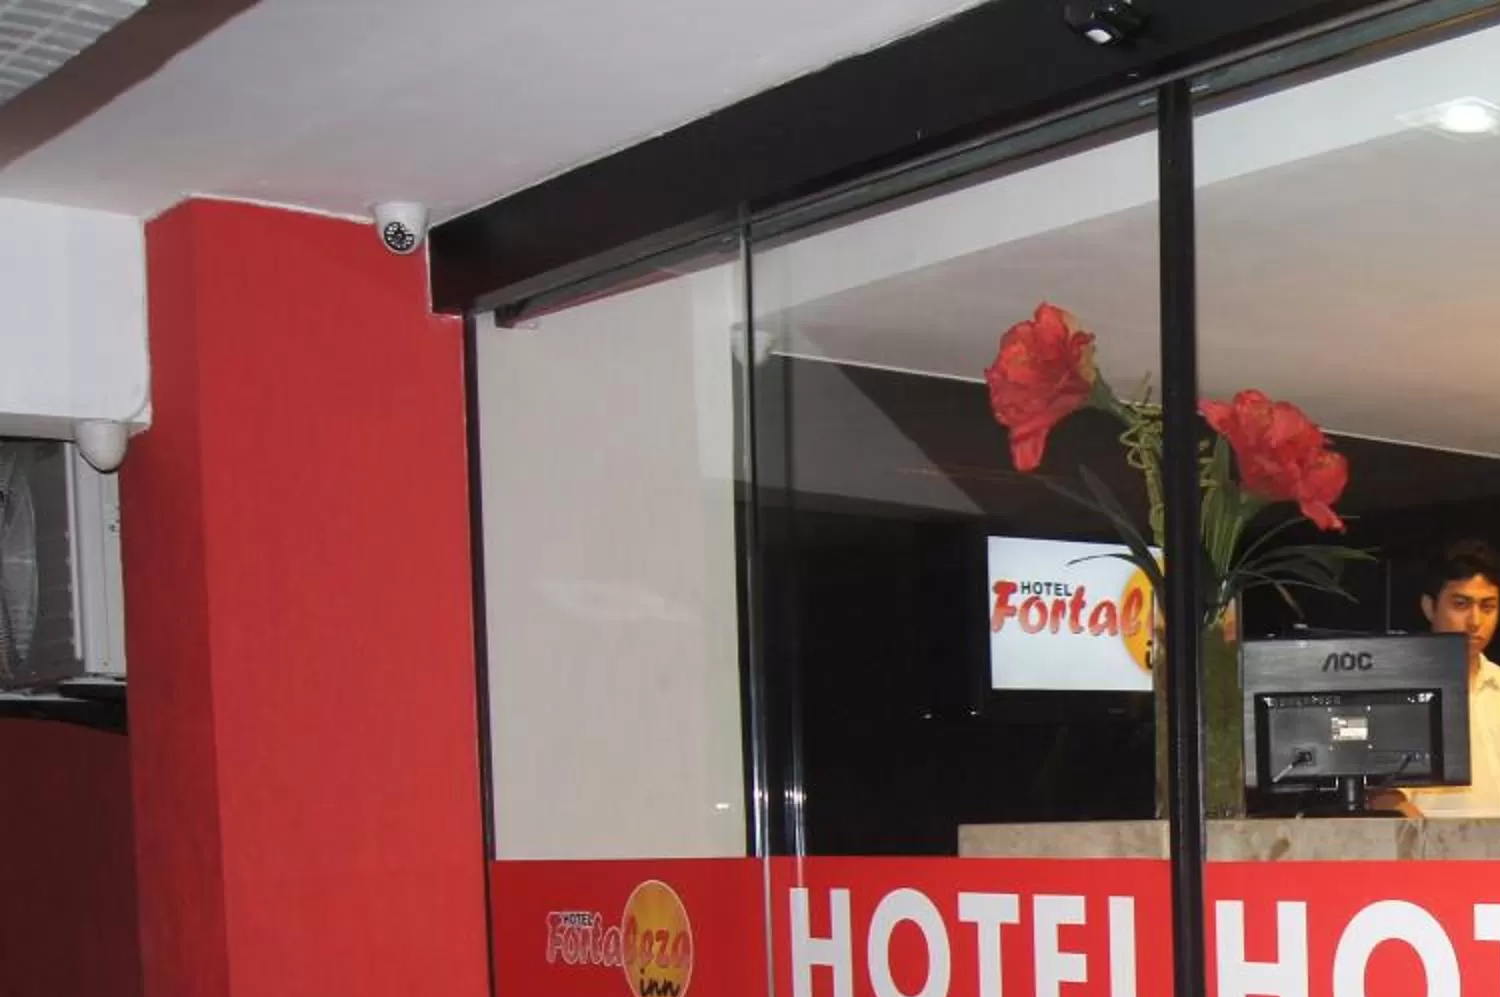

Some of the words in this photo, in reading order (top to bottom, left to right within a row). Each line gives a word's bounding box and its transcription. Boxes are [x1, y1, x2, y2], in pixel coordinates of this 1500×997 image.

[1020, 581, 1072, 597] HOTEL
[992, 580, 1154, 637] Fortal
[1322, 652, 1374, 672] AOC
[563, 913, 593, 927] HOTEL
[546, 912, 691, 968] Fortaleza
[639, 967, 681, 997] inn
